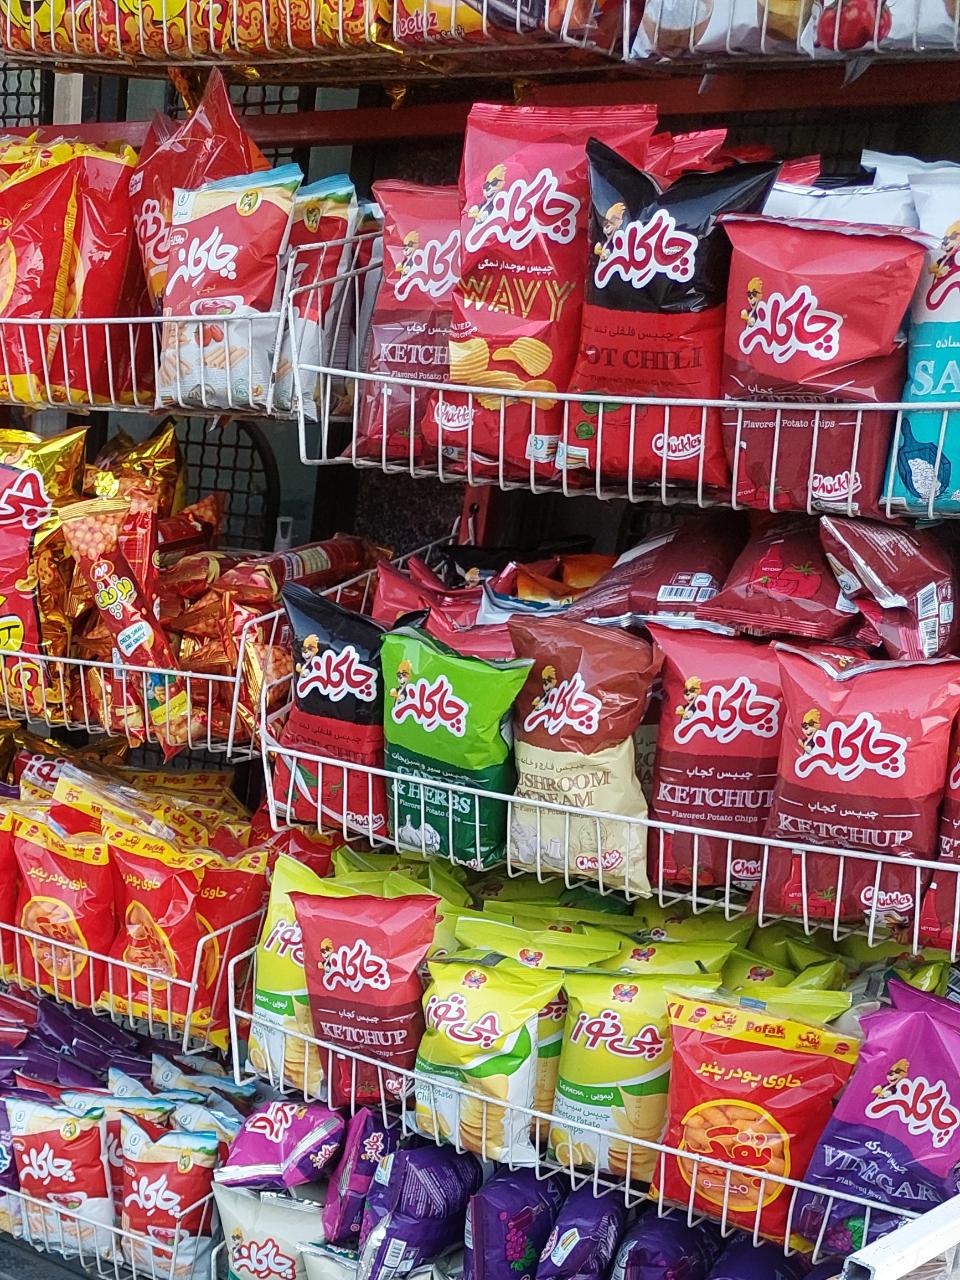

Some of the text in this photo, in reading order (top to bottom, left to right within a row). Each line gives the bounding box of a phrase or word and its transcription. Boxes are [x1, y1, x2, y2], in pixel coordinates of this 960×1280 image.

[465, 169, 580, 251] چاکلز
[478, 258, 499, 270] نمکی
[595, 209, 697, 288] چاکلز
[527, 262, 554, 276] چیپس
[457, 274, 576, 322] WAVY
[741, 286, 843, 363] چاکلز
[379, 342, 450, 365] KETCH
[911, 360, 960, 396] SA
[782, 419, 809, 428] Potato
[297, 645, 378, 702] چاکلز
[392, 675, 469, 737] چاکلز
[524, 672, 602, 735] چاکلز
[674, 677, 779, 744] چاکلز
[795, 712, 907, 781] چاکلز
[686, 766, 753, 780] چیپس کچاپ
[671, 810, 758, 824] Flavored Potato Chips
[807, 801, 879, 821] چیپس کچاپ
[777, 811, 913, 847] KETCHUP
[141, 878, 161, 891] حاوی
[200, 886, 228, 899] حاوی
[323, 939, 390, 991] چاکلز
[319, 1021, 407, 1046] KETCHUP
[745, 1020, 786, 1036] Pofak
[696, 1060, 801, 1090] حاوی پودر پنیر
[577, 1116, 601, 1129] Potato
[823, 1144, 944, 1203] VINEGAR
